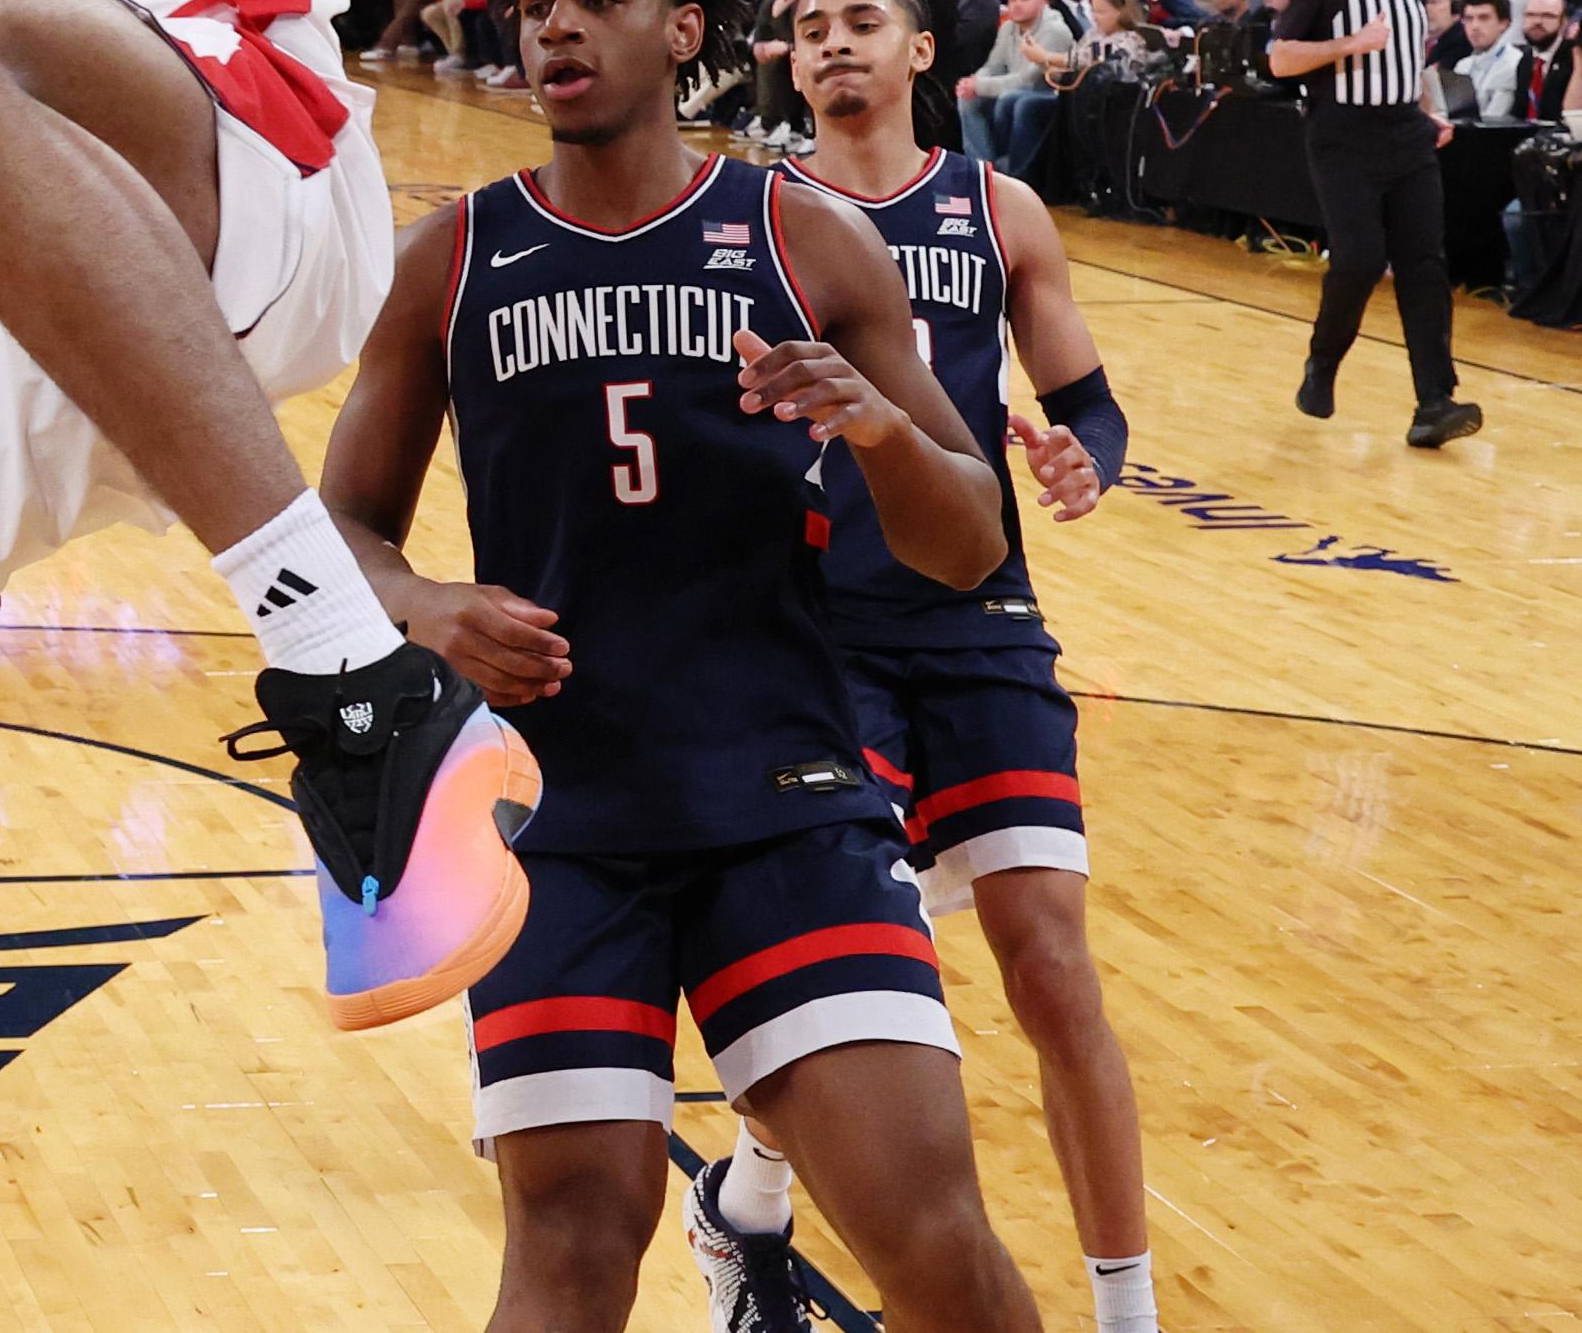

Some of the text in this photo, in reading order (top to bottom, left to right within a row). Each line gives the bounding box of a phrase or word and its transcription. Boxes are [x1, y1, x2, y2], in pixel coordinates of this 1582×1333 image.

[705, 257, 757, 269] EAST
[712, 248, 748, 259] BIG
[488, 284, 756, 383] CONNECTICUT
[604, 379, 658, 505] 5
